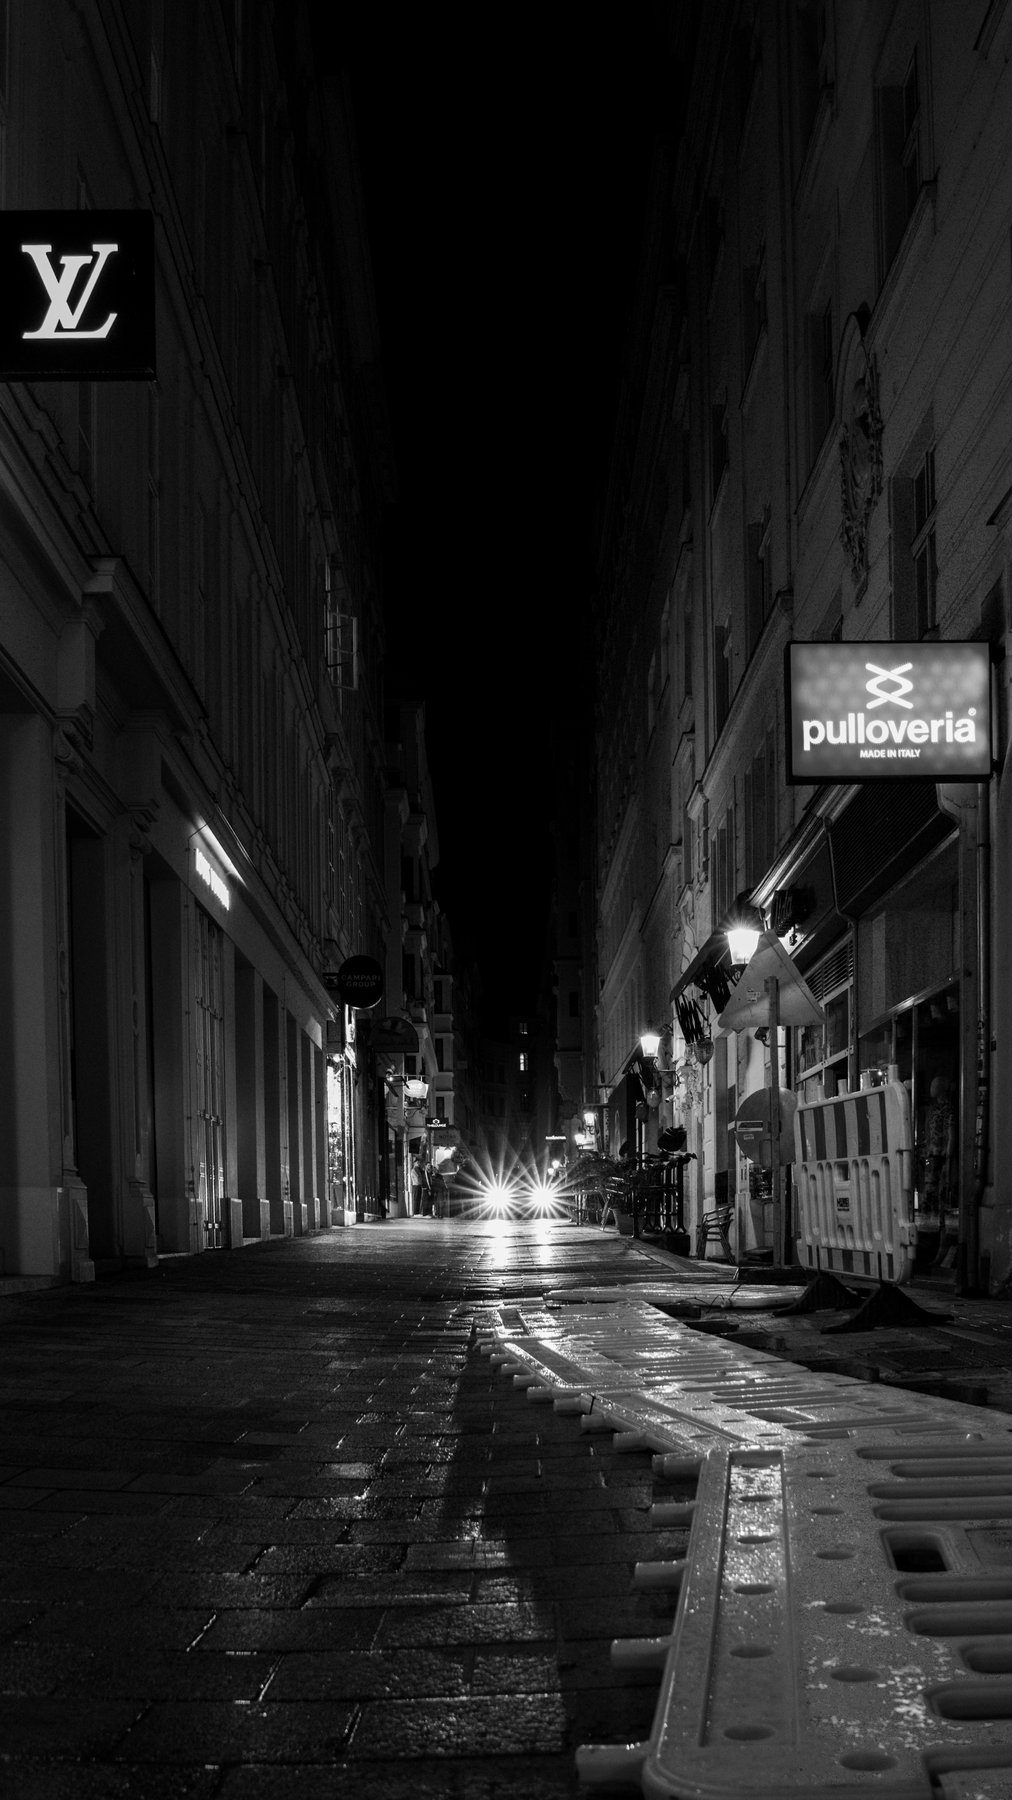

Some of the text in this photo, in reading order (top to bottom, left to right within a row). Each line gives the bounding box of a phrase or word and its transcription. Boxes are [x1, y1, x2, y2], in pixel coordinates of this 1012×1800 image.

[860, 748, 921, 758] MADE IN ITALY
